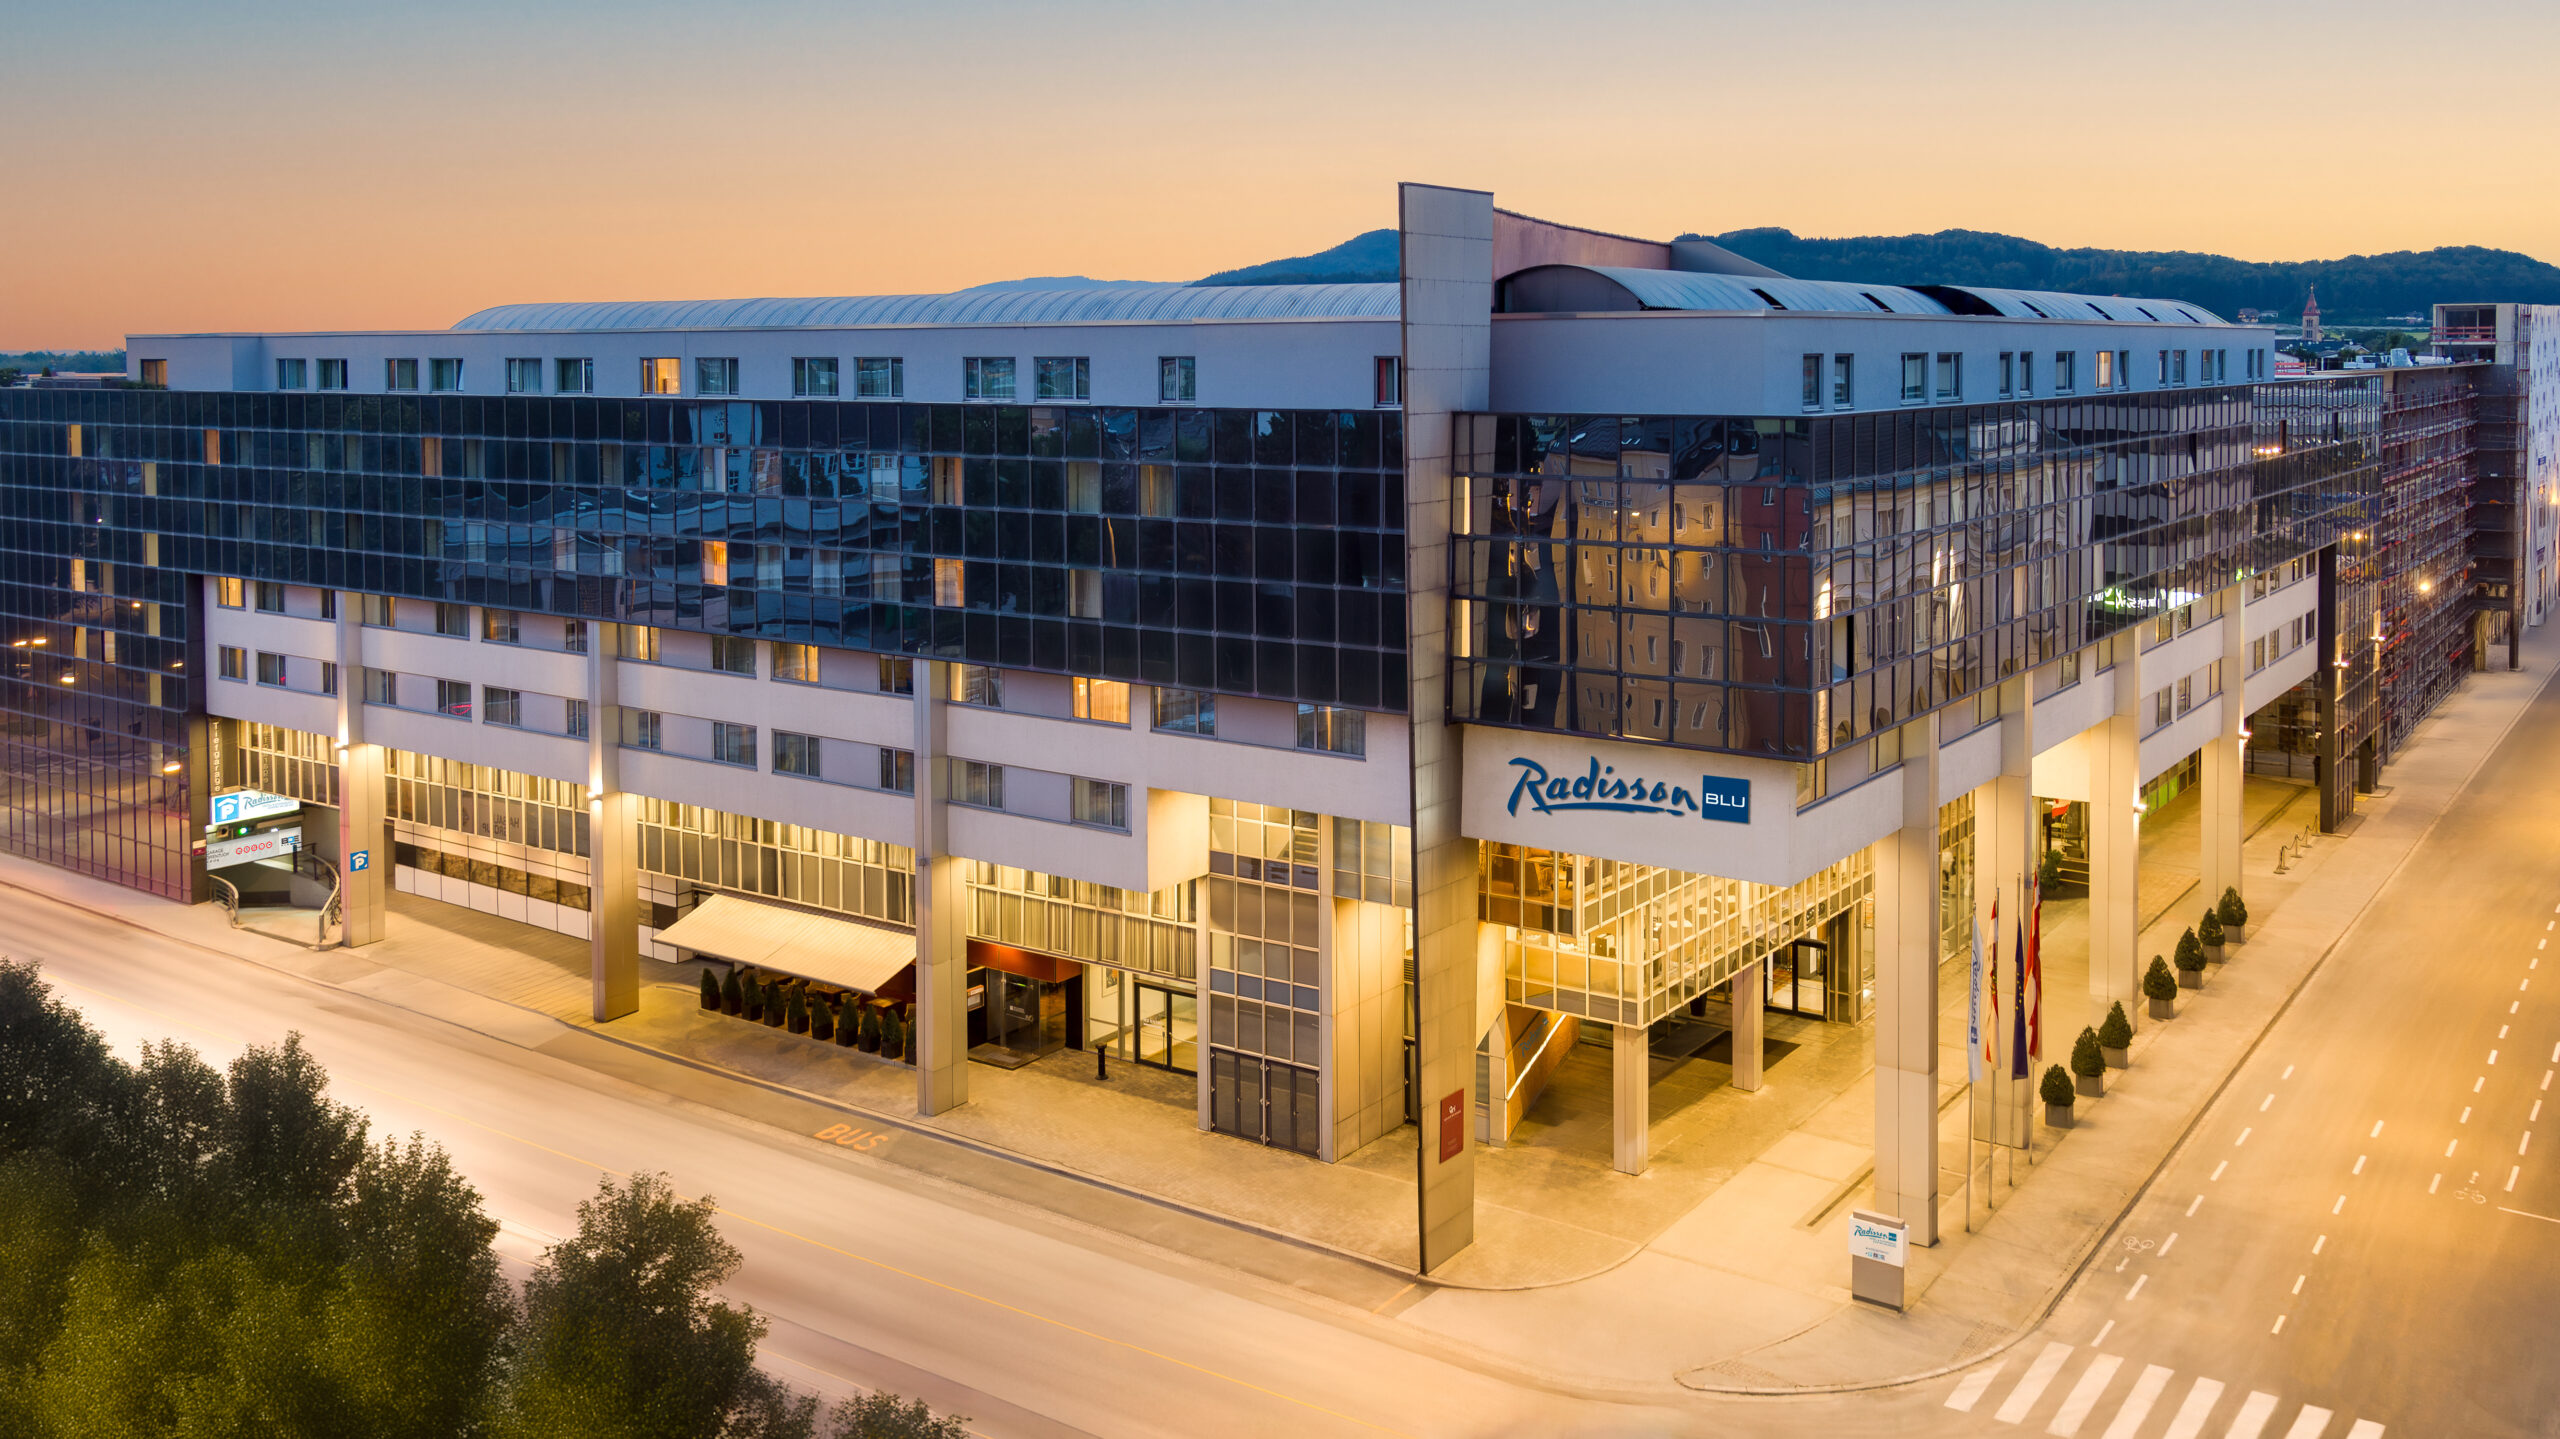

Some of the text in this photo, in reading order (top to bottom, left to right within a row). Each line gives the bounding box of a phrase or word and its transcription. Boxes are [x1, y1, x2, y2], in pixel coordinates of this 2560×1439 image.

[213, 721, 221, 792] Tiefgarage
[1507, 756, 1746, 817] Radisson BLU
[813, 1123, 889, 1151] BUS
[1854, 1225, 1888, 1239] Radisson
